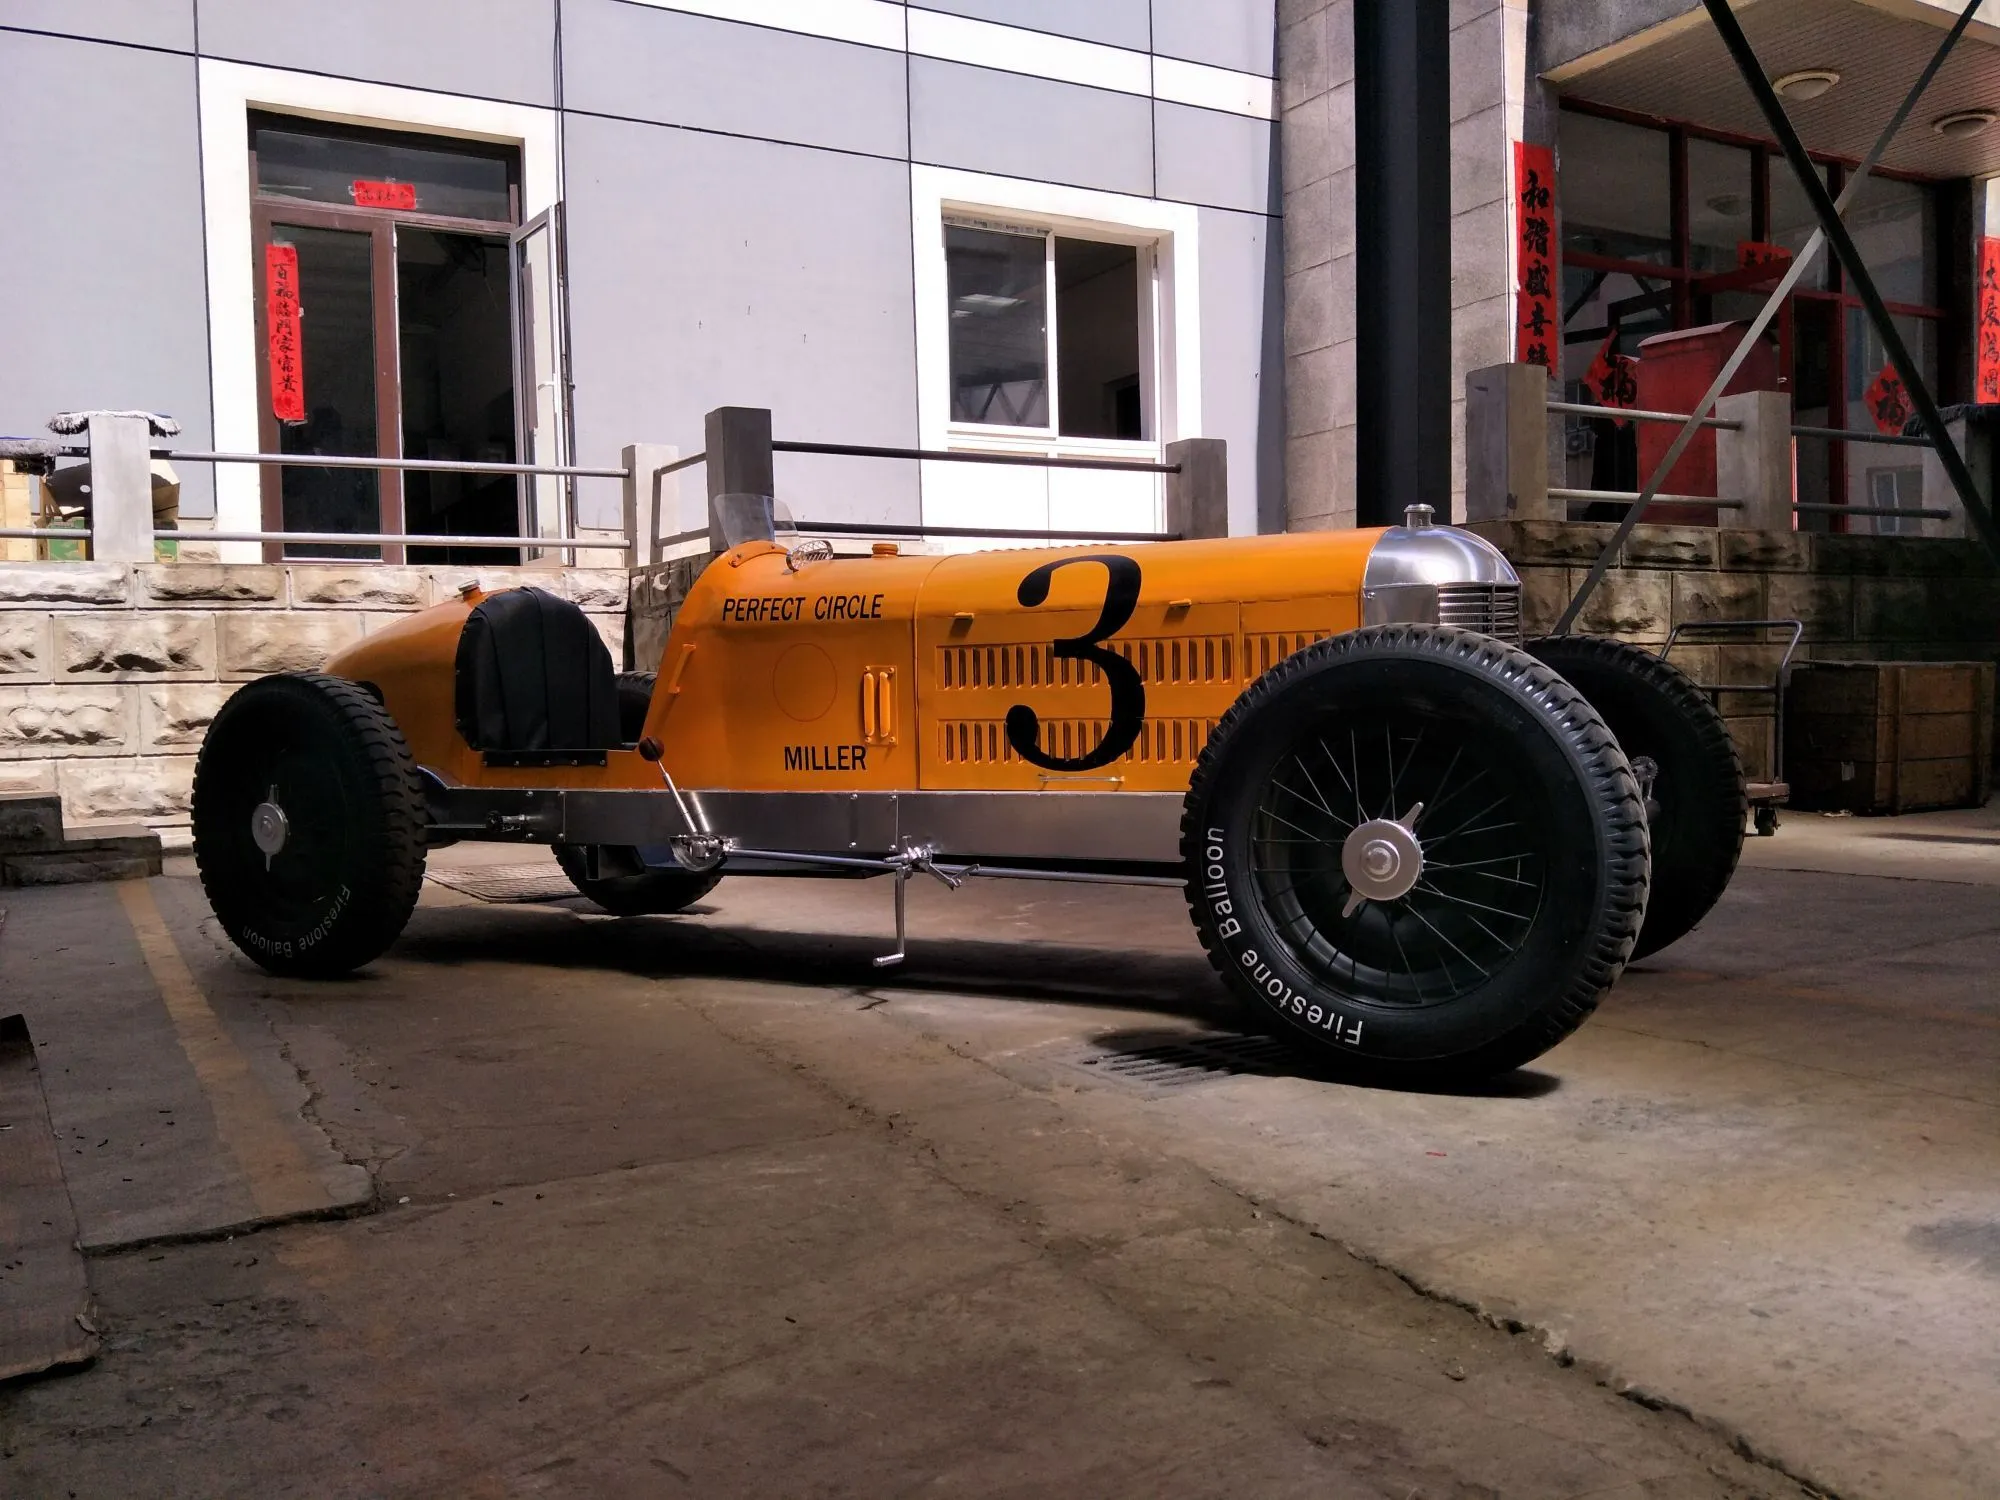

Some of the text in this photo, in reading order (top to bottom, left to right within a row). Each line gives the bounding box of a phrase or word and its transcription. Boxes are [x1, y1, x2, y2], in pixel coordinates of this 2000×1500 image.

[722, 594, 884, 622] PERFECT CIRCLE
[1006, 555, 1146, 772] 3
[784, 745, 867, 771] MILLER
[242, 884, 351, 958] Firestone Balloon
[1206, 827, 1364, 1046] Firestone Balloon
